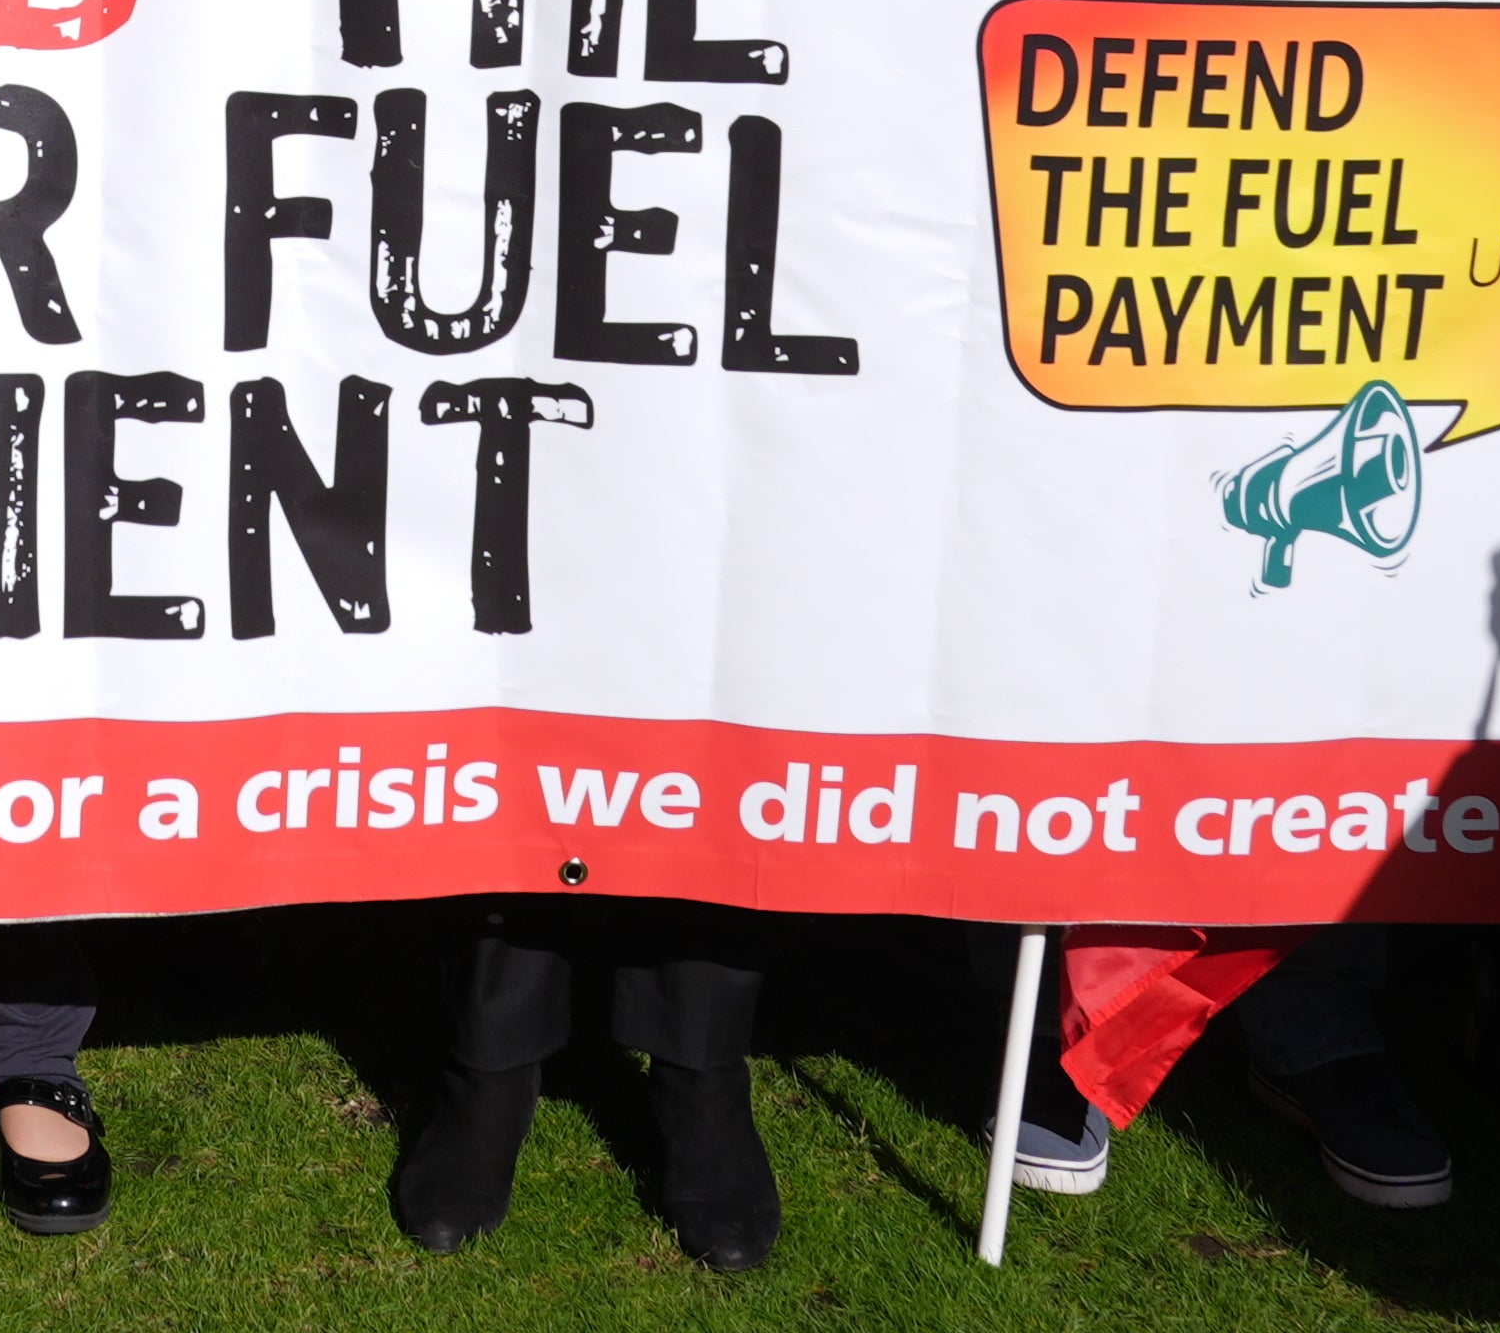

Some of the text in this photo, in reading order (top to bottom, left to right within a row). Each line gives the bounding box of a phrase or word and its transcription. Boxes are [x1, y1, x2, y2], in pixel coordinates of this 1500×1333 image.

[1015, 33, 1365, 133] DEFEND
[220, 83, 861, 378] FUEL
[1029, 155, 1420, 249] THE FUEL
[1040, 273, 1445, 366] PAYMENT
[138, 777, 200, 841] a
[235, 742, 499, 832] crisis
[536, 764, 701, 828] we
[738, 761, 918, 845] did
[954, 777, 1140, 854] not
